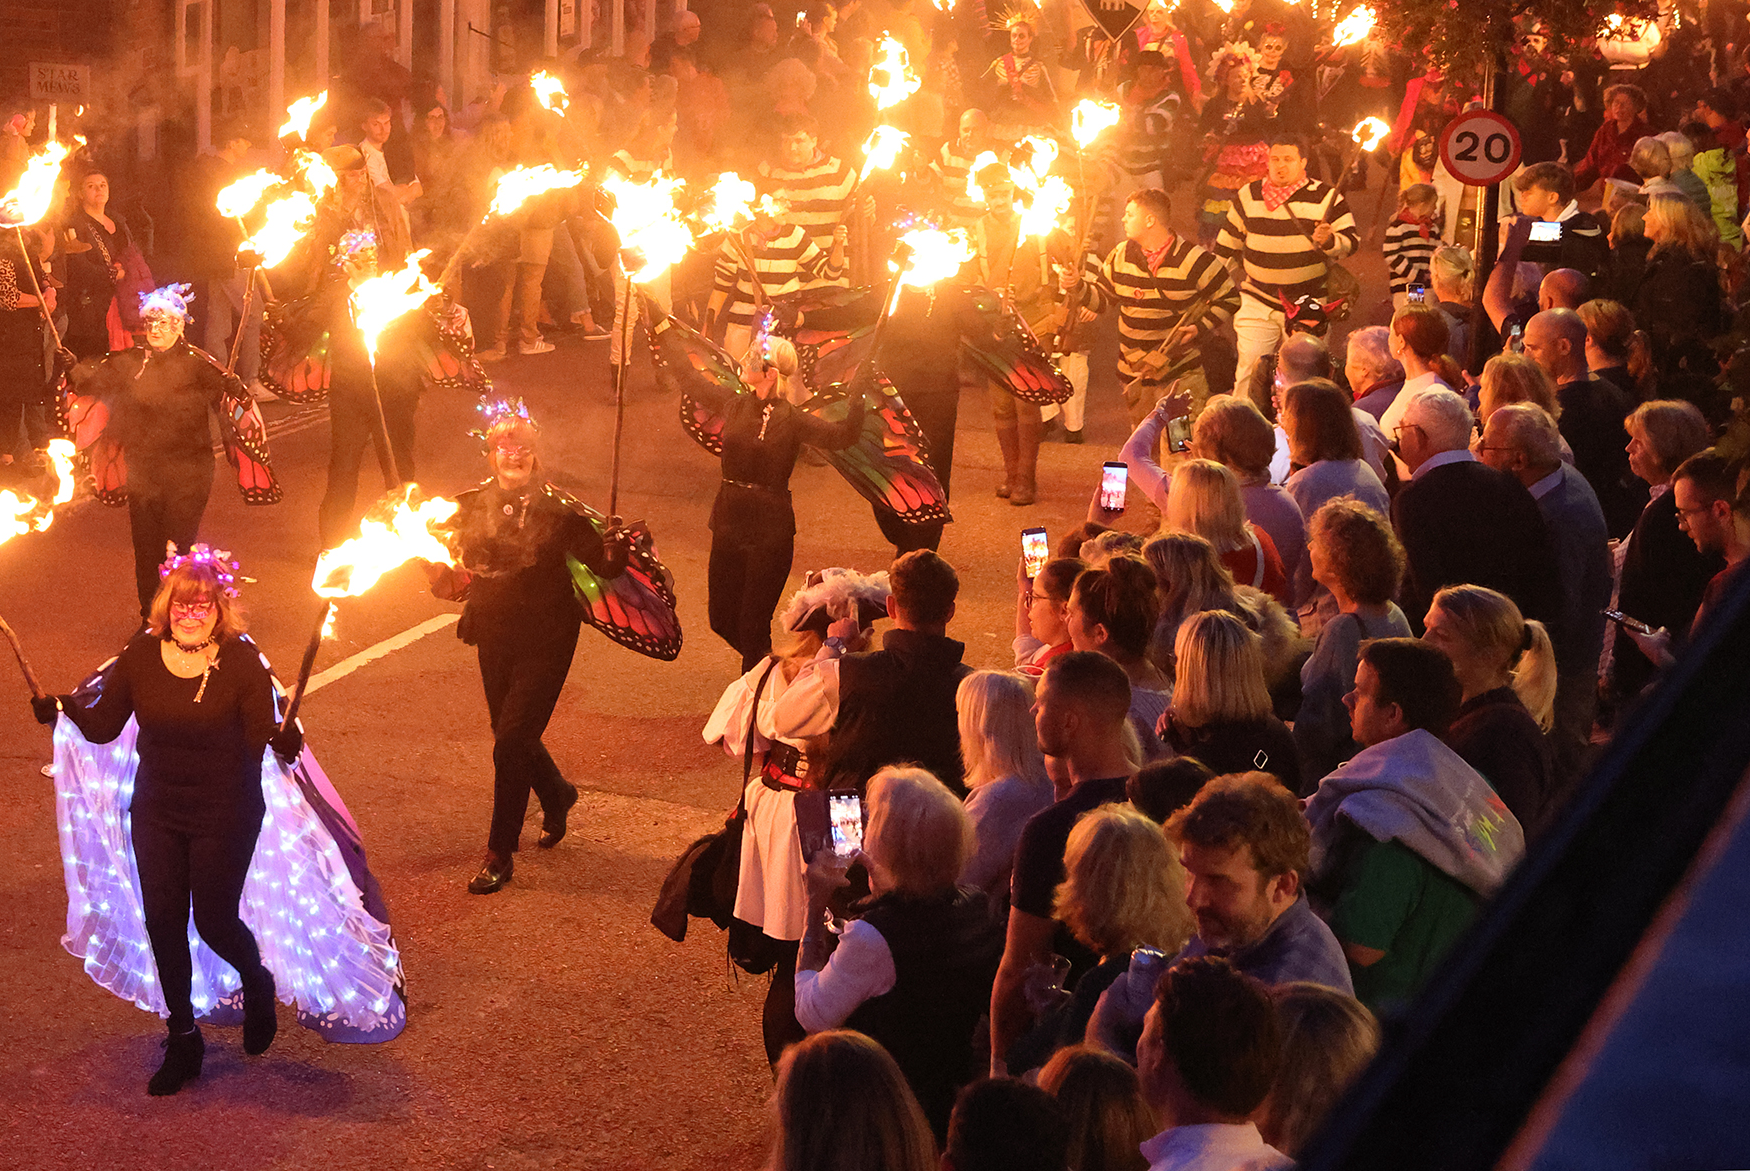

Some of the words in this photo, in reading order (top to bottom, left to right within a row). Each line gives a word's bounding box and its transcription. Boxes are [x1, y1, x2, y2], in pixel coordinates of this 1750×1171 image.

[37, 68, 79, 81] STAR
[36, 81, 81, 95] MEWS
[1455, 131, 1511, 164] 20
